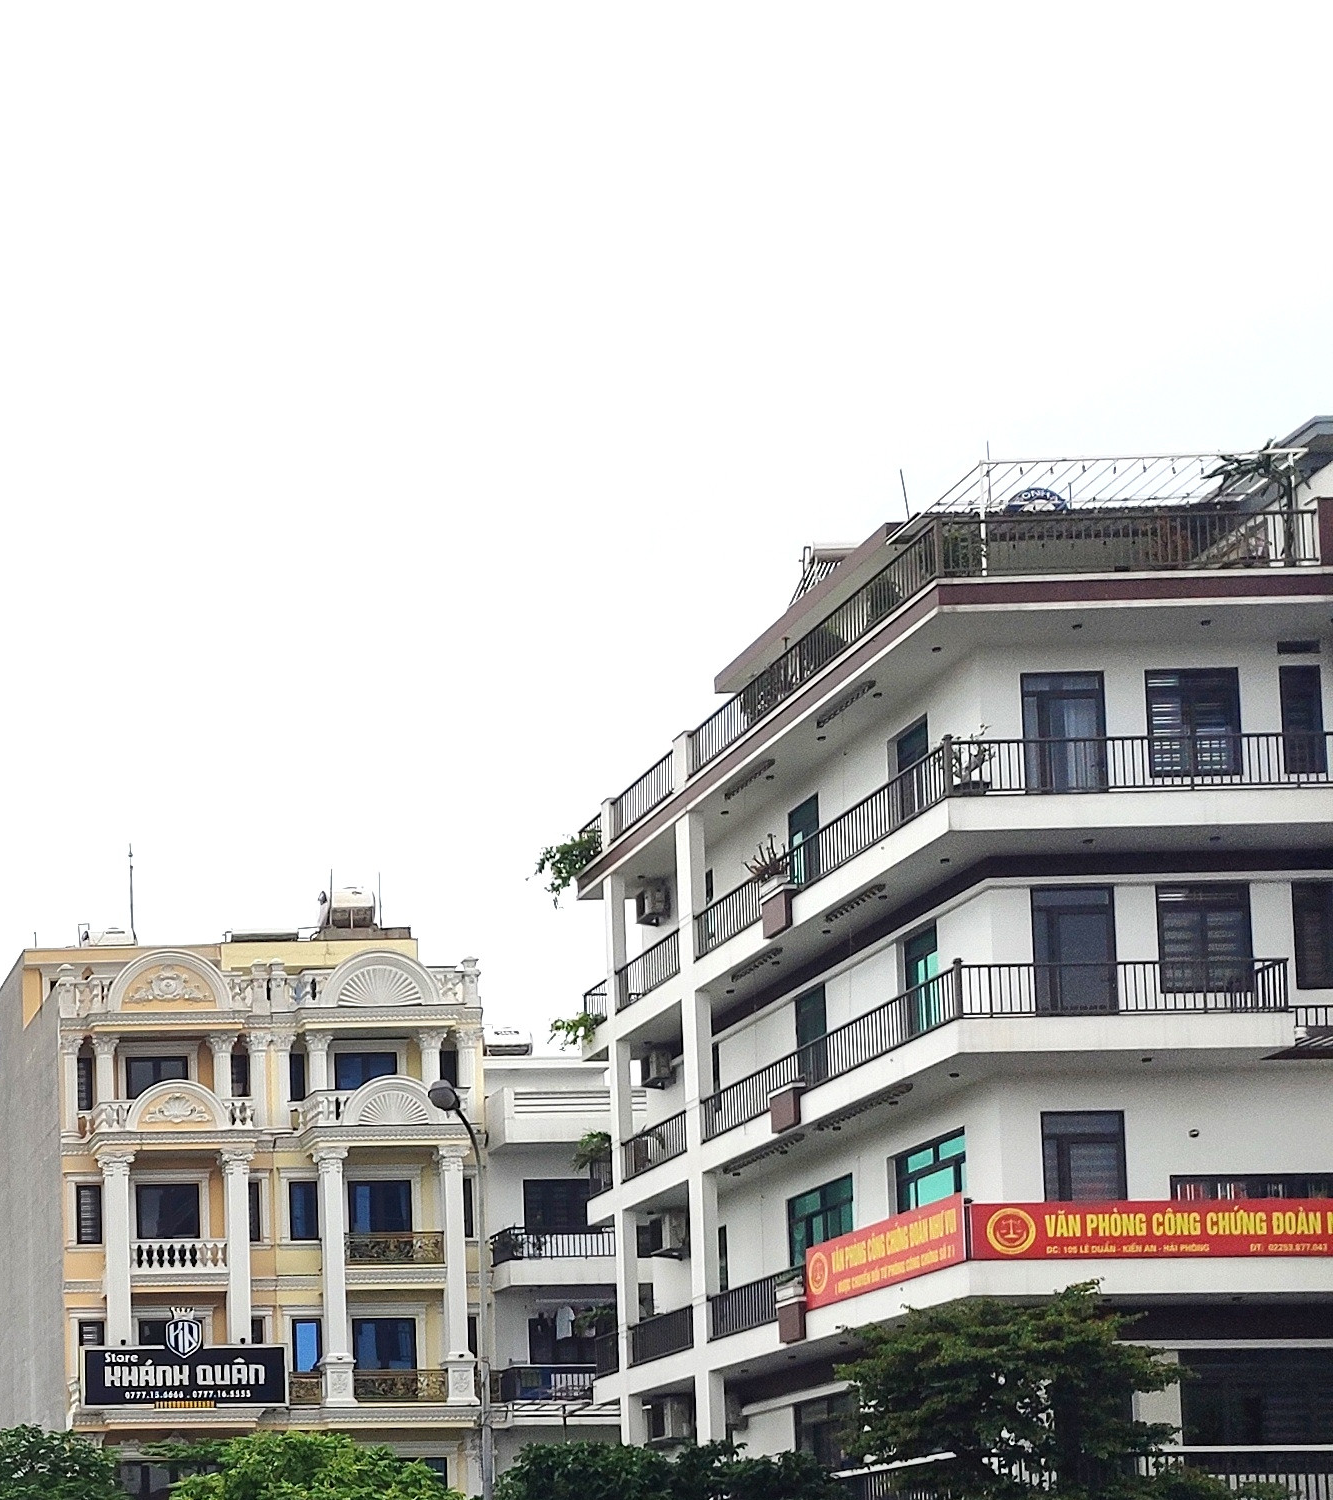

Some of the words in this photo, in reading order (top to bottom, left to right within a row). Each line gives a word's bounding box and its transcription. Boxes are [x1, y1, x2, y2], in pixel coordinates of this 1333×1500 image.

[1045, 1210, 1081, 1238] VĂN
[1086, 1207, 1147, 1237] PHÒNG
[1152, 1207, 1201, 1236] CÔNG
[1206, 1205, 1267, 1236] CHỨNG
[1272, 1206, 1322, 1235] ĐOÀN
[831, 1245, 844, 1274] VĂN
[845, 1238, 866, 1269] PHÒNG
[867, 1232, 885, 1262] CÔNG
[886, 1222, 908, 1255] CHỨNG
[104, 1352, 139, 1363] Store
[104, 1359, 189, 1387] KHÁNH
[196, 1357, 265, 1386] QUÂN
